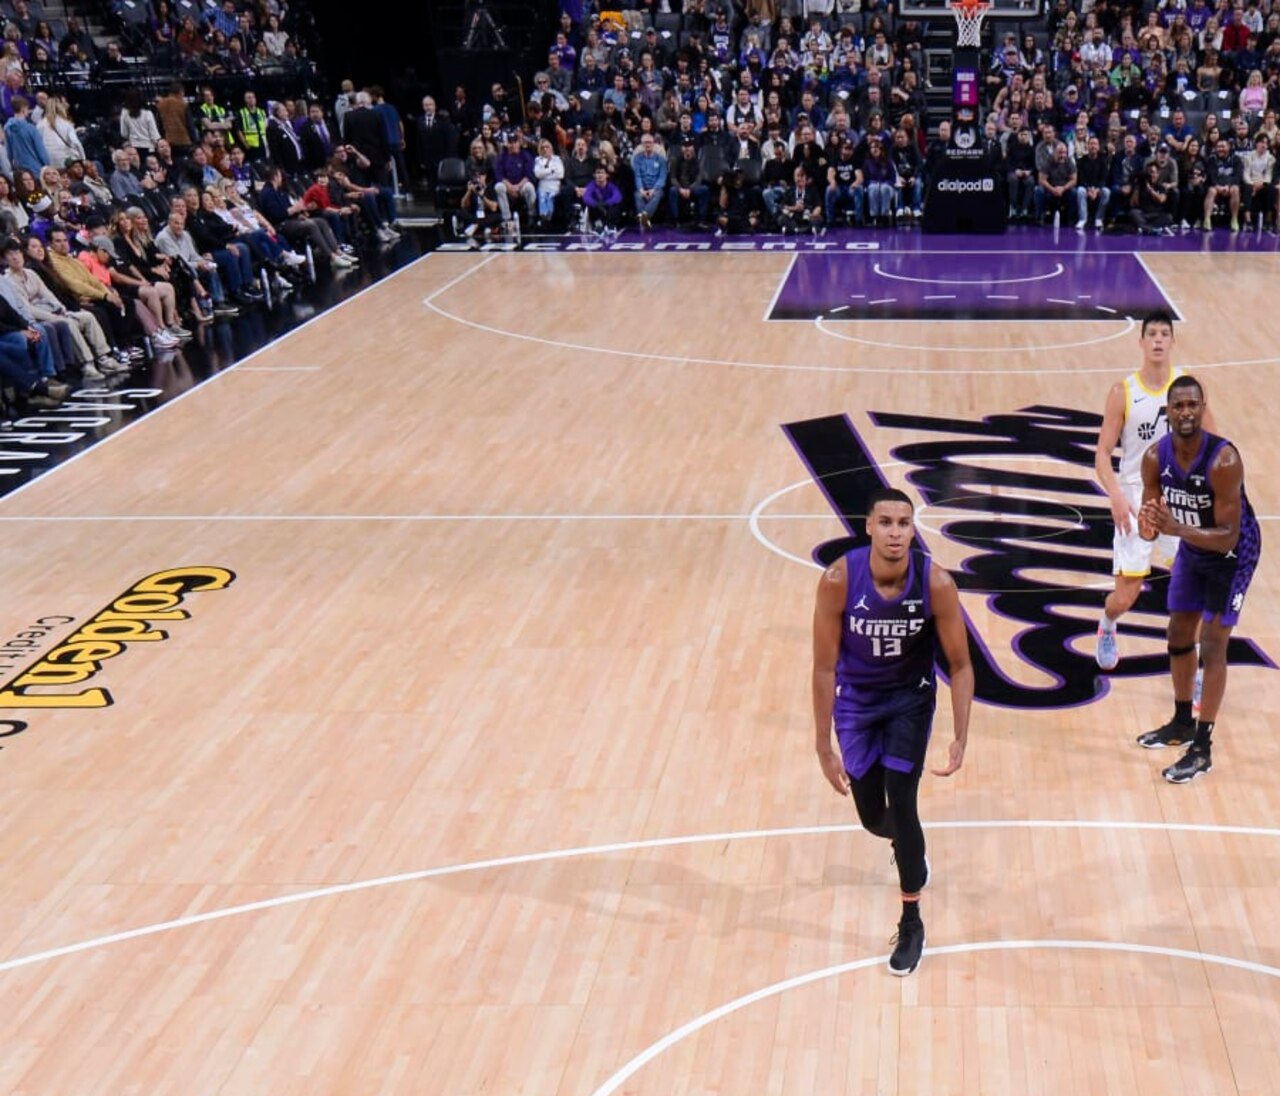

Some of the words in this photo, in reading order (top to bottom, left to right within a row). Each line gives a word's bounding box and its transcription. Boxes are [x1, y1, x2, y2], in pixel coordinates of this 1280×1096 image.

[938, 179, 982, 192] dialpad
[850, 615, 925, 637] KINGS
[870, 637, 902, 657] 13
